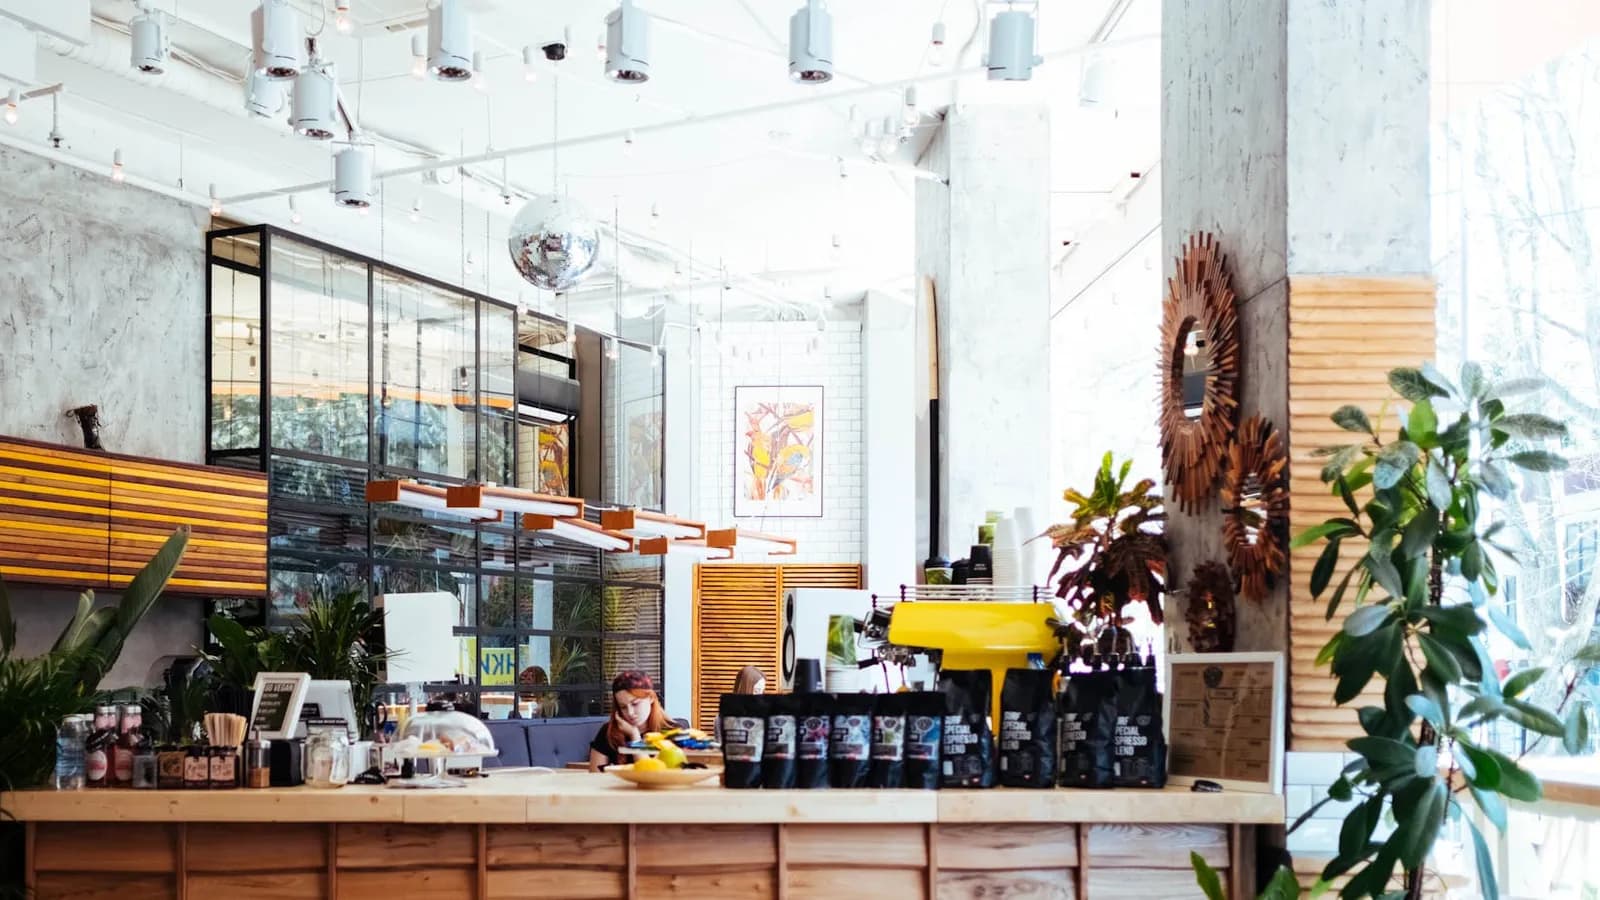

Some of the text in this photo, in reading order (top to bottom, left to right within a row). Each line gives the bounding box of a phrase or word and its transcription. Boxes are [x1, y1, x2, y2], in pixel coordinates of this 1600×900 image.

[944, 724, 971, 734] SPECIAL
[1115, 726, 1140, 736] PECIAL
[1114, 736, 1148, 746] SPRESSO
[1115, 746, 1135, 756] LEND
